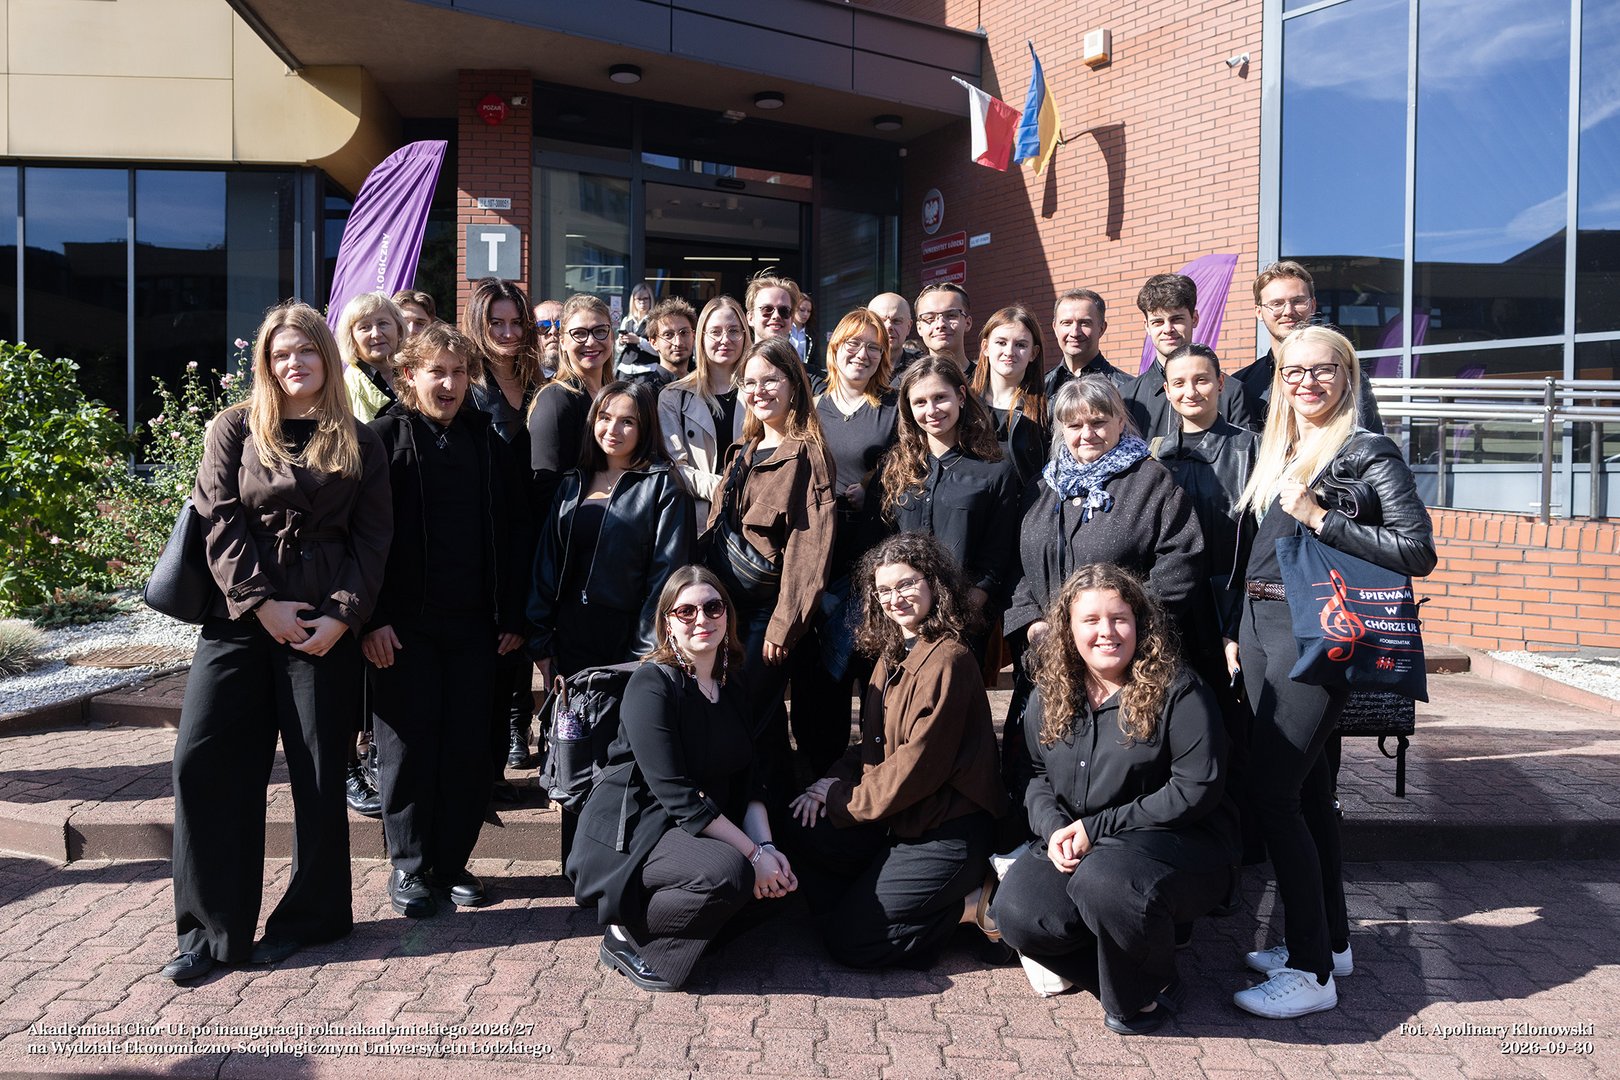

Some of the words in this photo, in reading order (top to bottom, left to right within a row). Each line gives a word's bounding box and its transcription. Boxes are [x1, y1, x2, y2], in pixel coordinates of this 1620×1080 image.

[481, 233, 506, 272] T
[376, 233, 390, 291] LOGICZNY
[1359, 590, 1412, 600] ŚPIEWAM
[1384, 606, 1398, 615] W
[1365, 620, 1406, 632] CHÓRZE
[1407, 622, 1418, 632] UŁ
